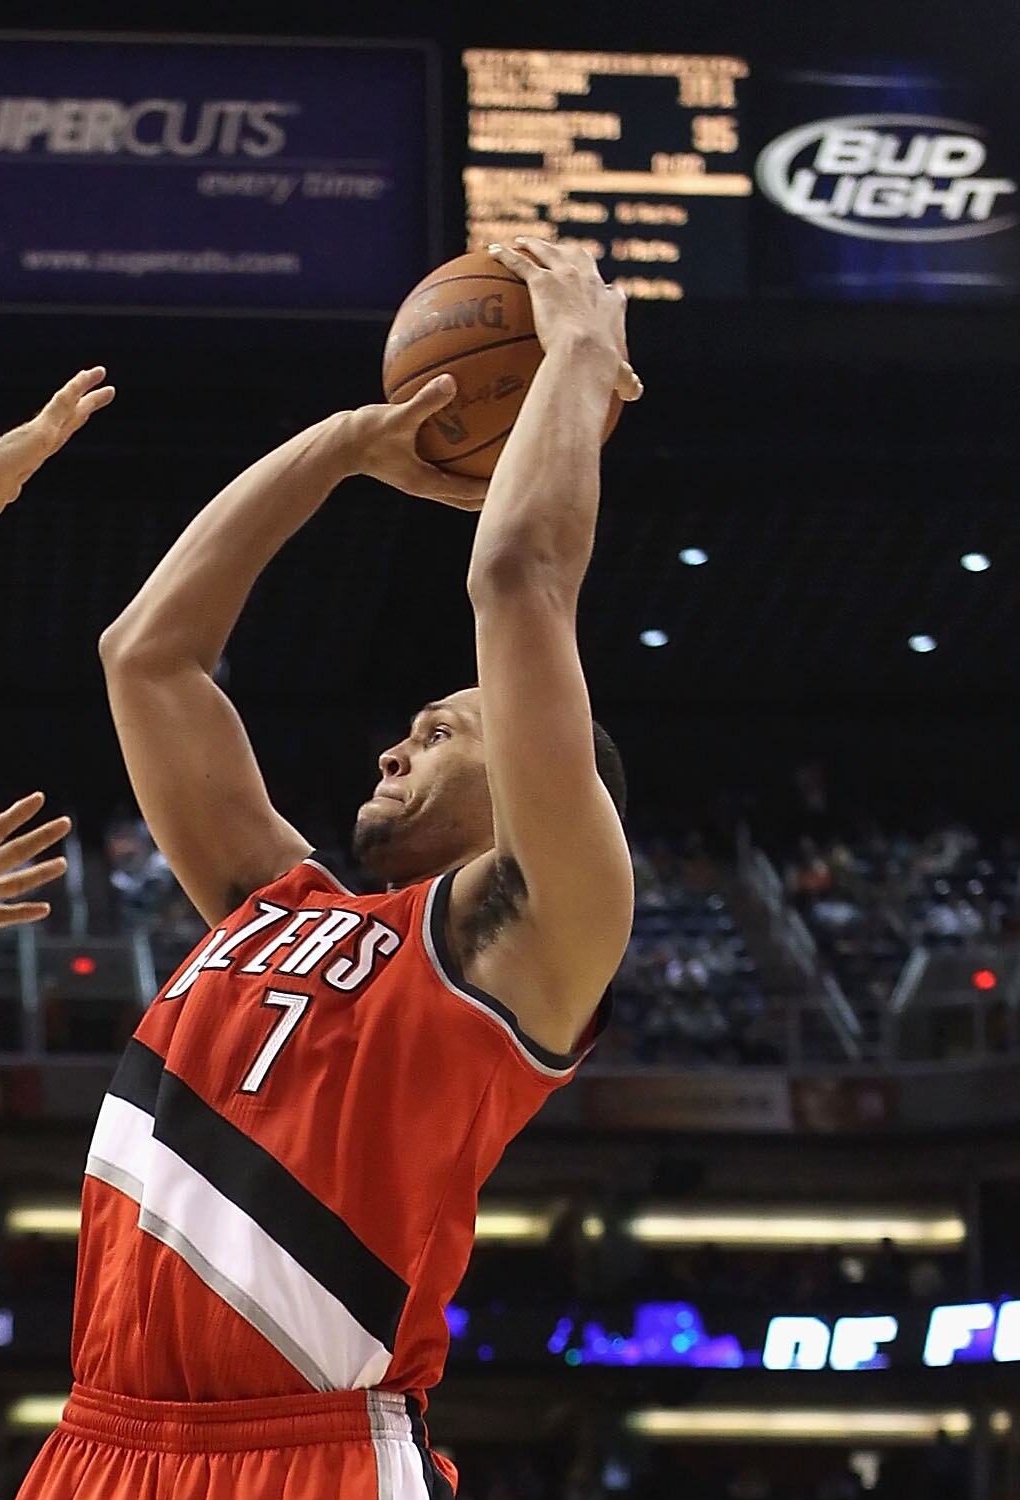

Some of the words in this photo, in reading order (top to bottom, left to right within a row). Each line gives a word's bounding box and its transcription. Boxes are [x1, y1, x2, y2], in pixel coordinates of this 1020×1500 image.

[814, 128, 987, 178] BUD
[791, 168, 1017, 221] LIGHT
[237, 987, 315, 1096] 7
